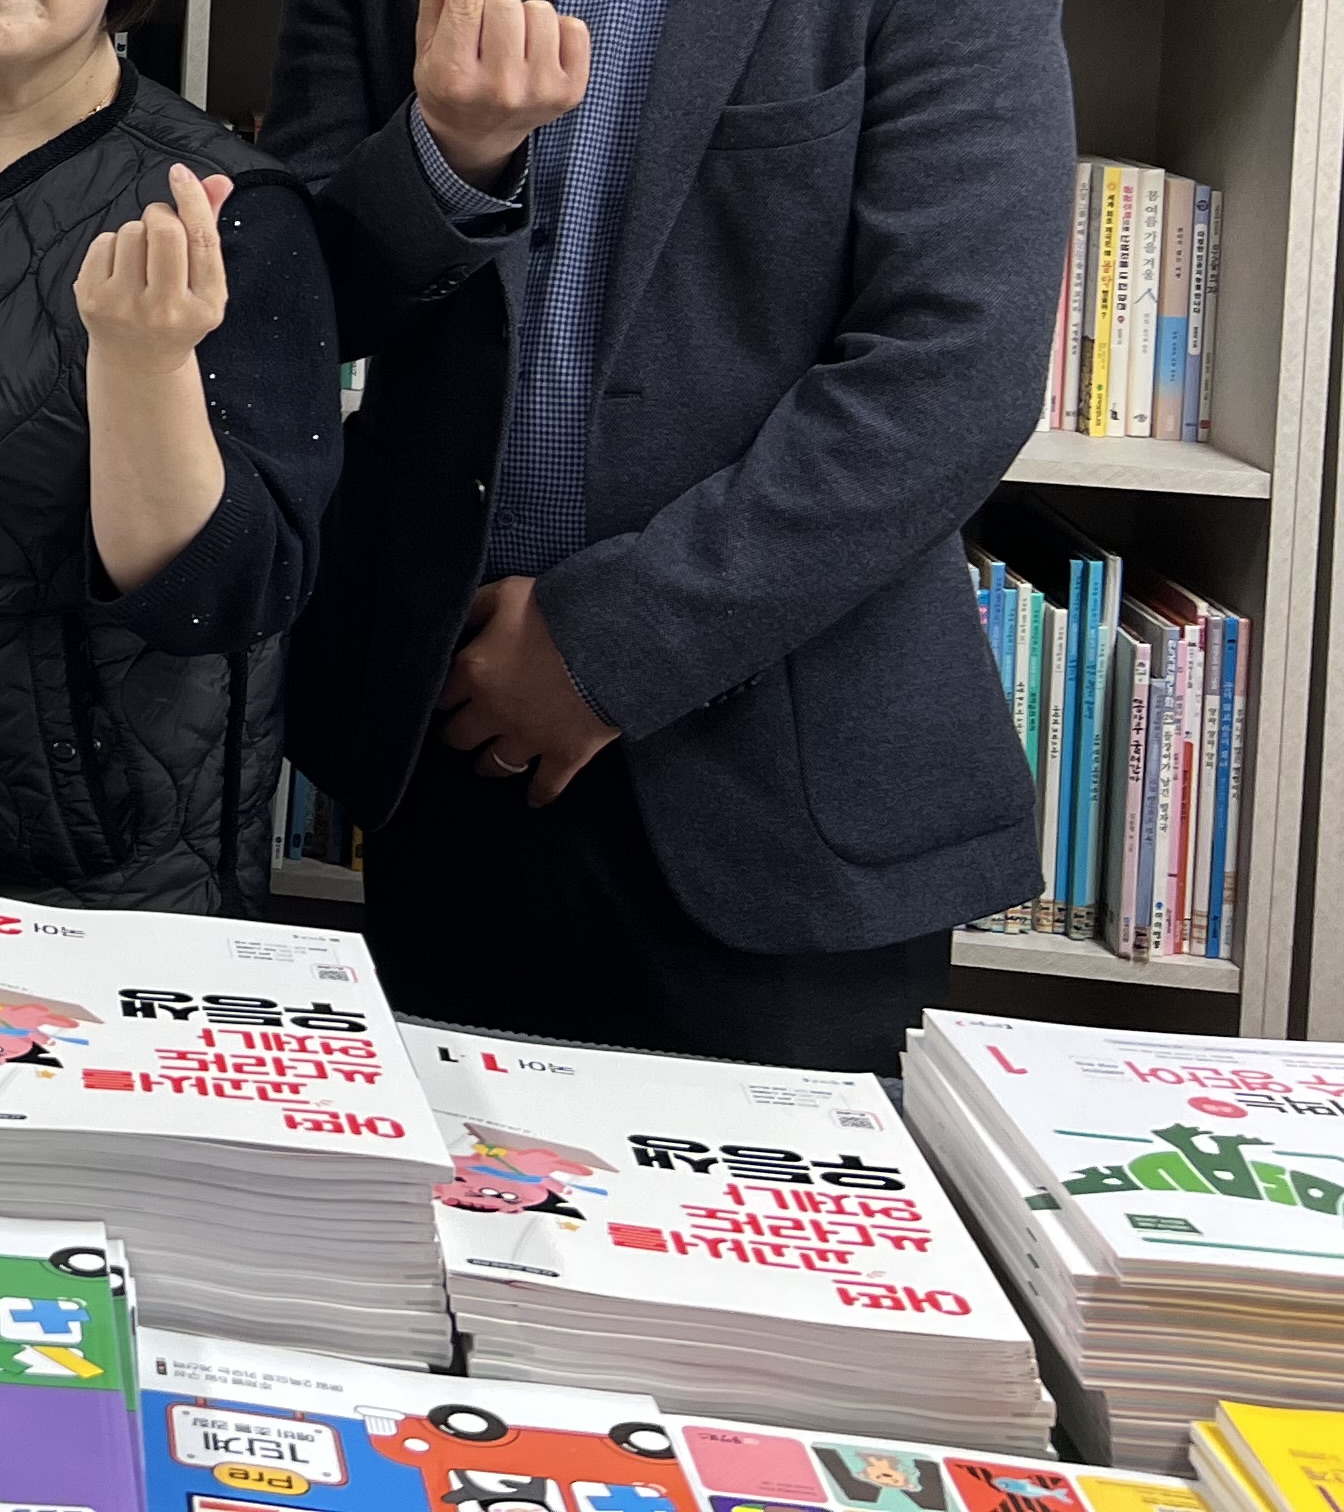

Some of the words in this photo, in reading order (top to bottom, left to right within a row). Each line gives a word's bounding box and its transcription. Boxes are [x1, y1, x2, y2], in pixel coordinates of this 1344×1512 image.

[1147, 190, 1158, 201] 봄
[1145, 205, 1158, 227] 여름
[1144, 231, 1157, 254] 가을
[1142, 258, 1155, 280] 겨울
[32, 922, 86, 939] 국어
[117, 988, 368, 1033] 우등생
[197, 1028, 376, 1060] 언제나
[985, 1045, 1028, 1074] 1
[154, 1049, 383, 1085] 쓰더라도
[517, 1058, 576, 1077] 국어
[1125, 1061, 1293, 1093] 영단어
[82, 1068, 310, 1105] 교과서를
[282, 1108, 406, 1139] 어떤
[626, 1135, 906, 1192] 우등생
[1061, 1123, 1344, 1216] OSAUR
[722, 1184, 922, 1222] 언제나
[680, 1204, 933, 1253] 쓰더라도
[607, 1222, 863, 1276] 교과서를
[831, 1280, 972, 1316] 어떤
[203, 1431, 310, 1464] 1단계
[229, 1468, 293, 1489] Pre
